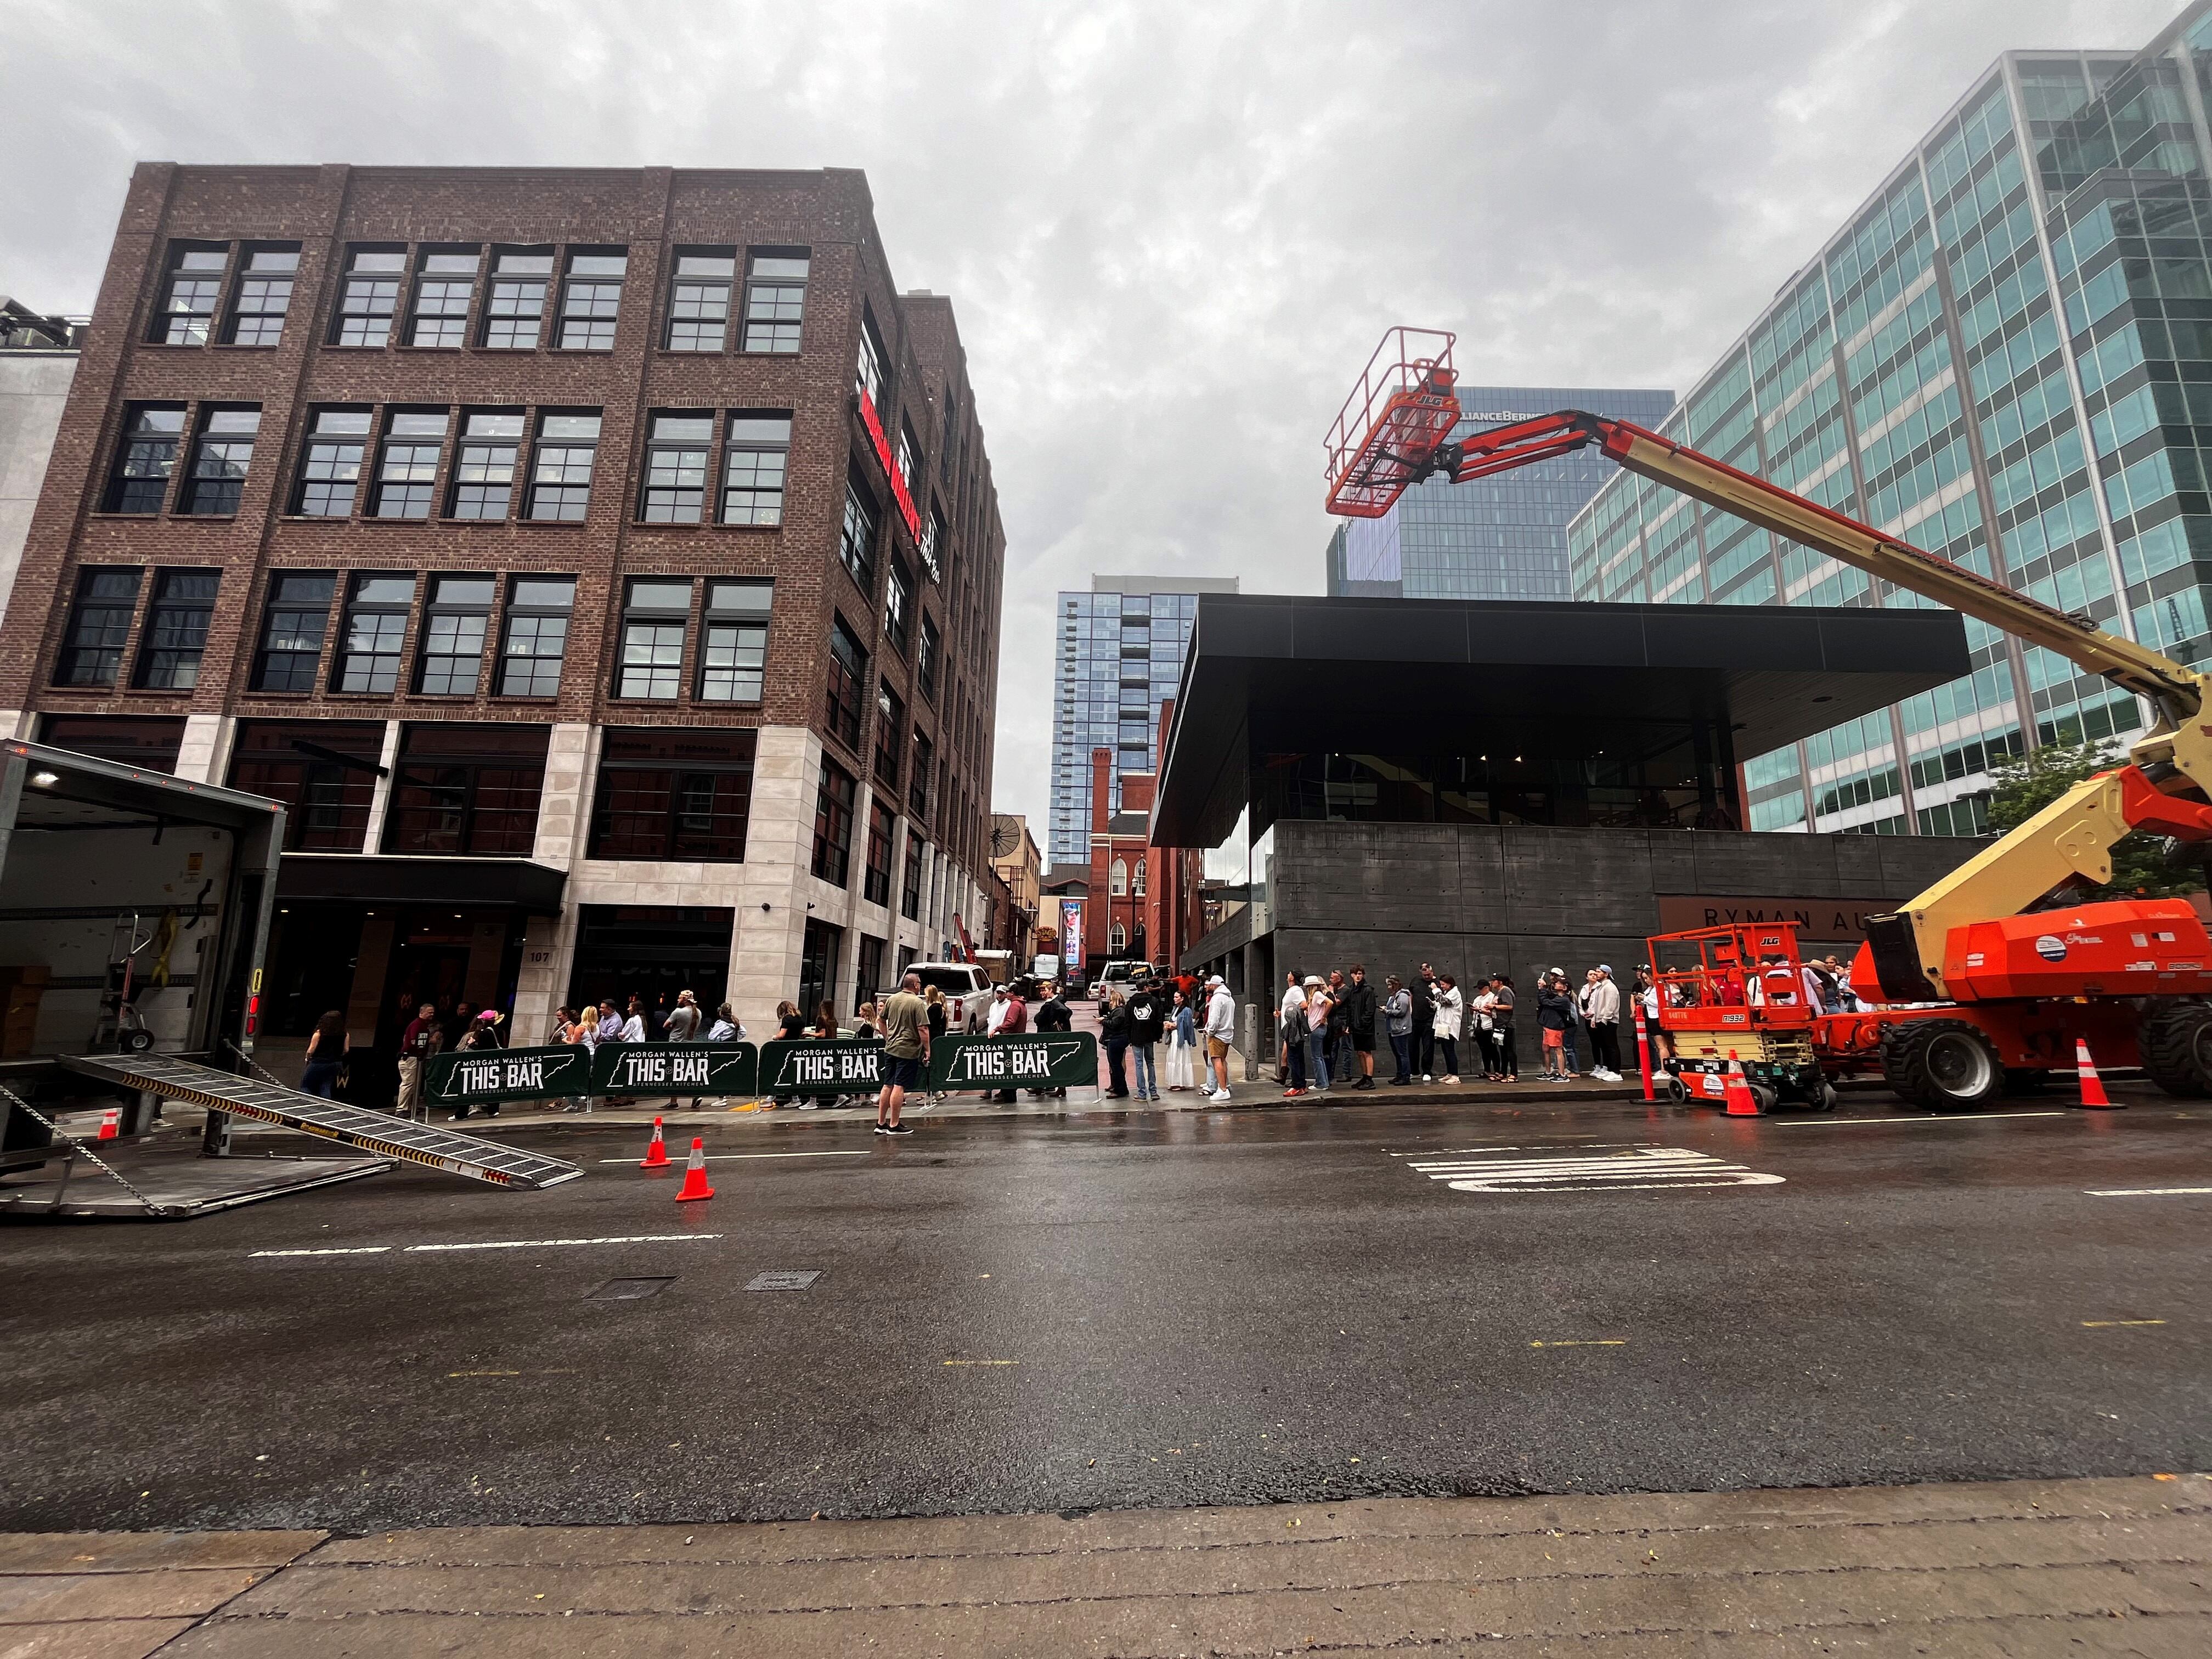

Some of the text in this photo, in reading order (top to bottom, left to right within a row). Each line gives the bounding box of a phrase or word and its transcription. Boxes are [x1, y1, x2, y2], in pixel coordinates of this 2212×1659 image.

[1417, 396, 1442, 405] JLG
[1704, 908, 1810, 929] RYMAN
[1760, 937, 1779, 945] JLG
[531, 952, 549, 962] 107
[1007, 1042, 1047, 1051] WALLEN'S
[626, 1059, 709, 1085] THIS BAR
[793, 1055, 879, 1084] THIS BAR
[963, 1050, 1051, 1079] THIS BAR
[460, 1063, 544, 1094] THIS BAR
